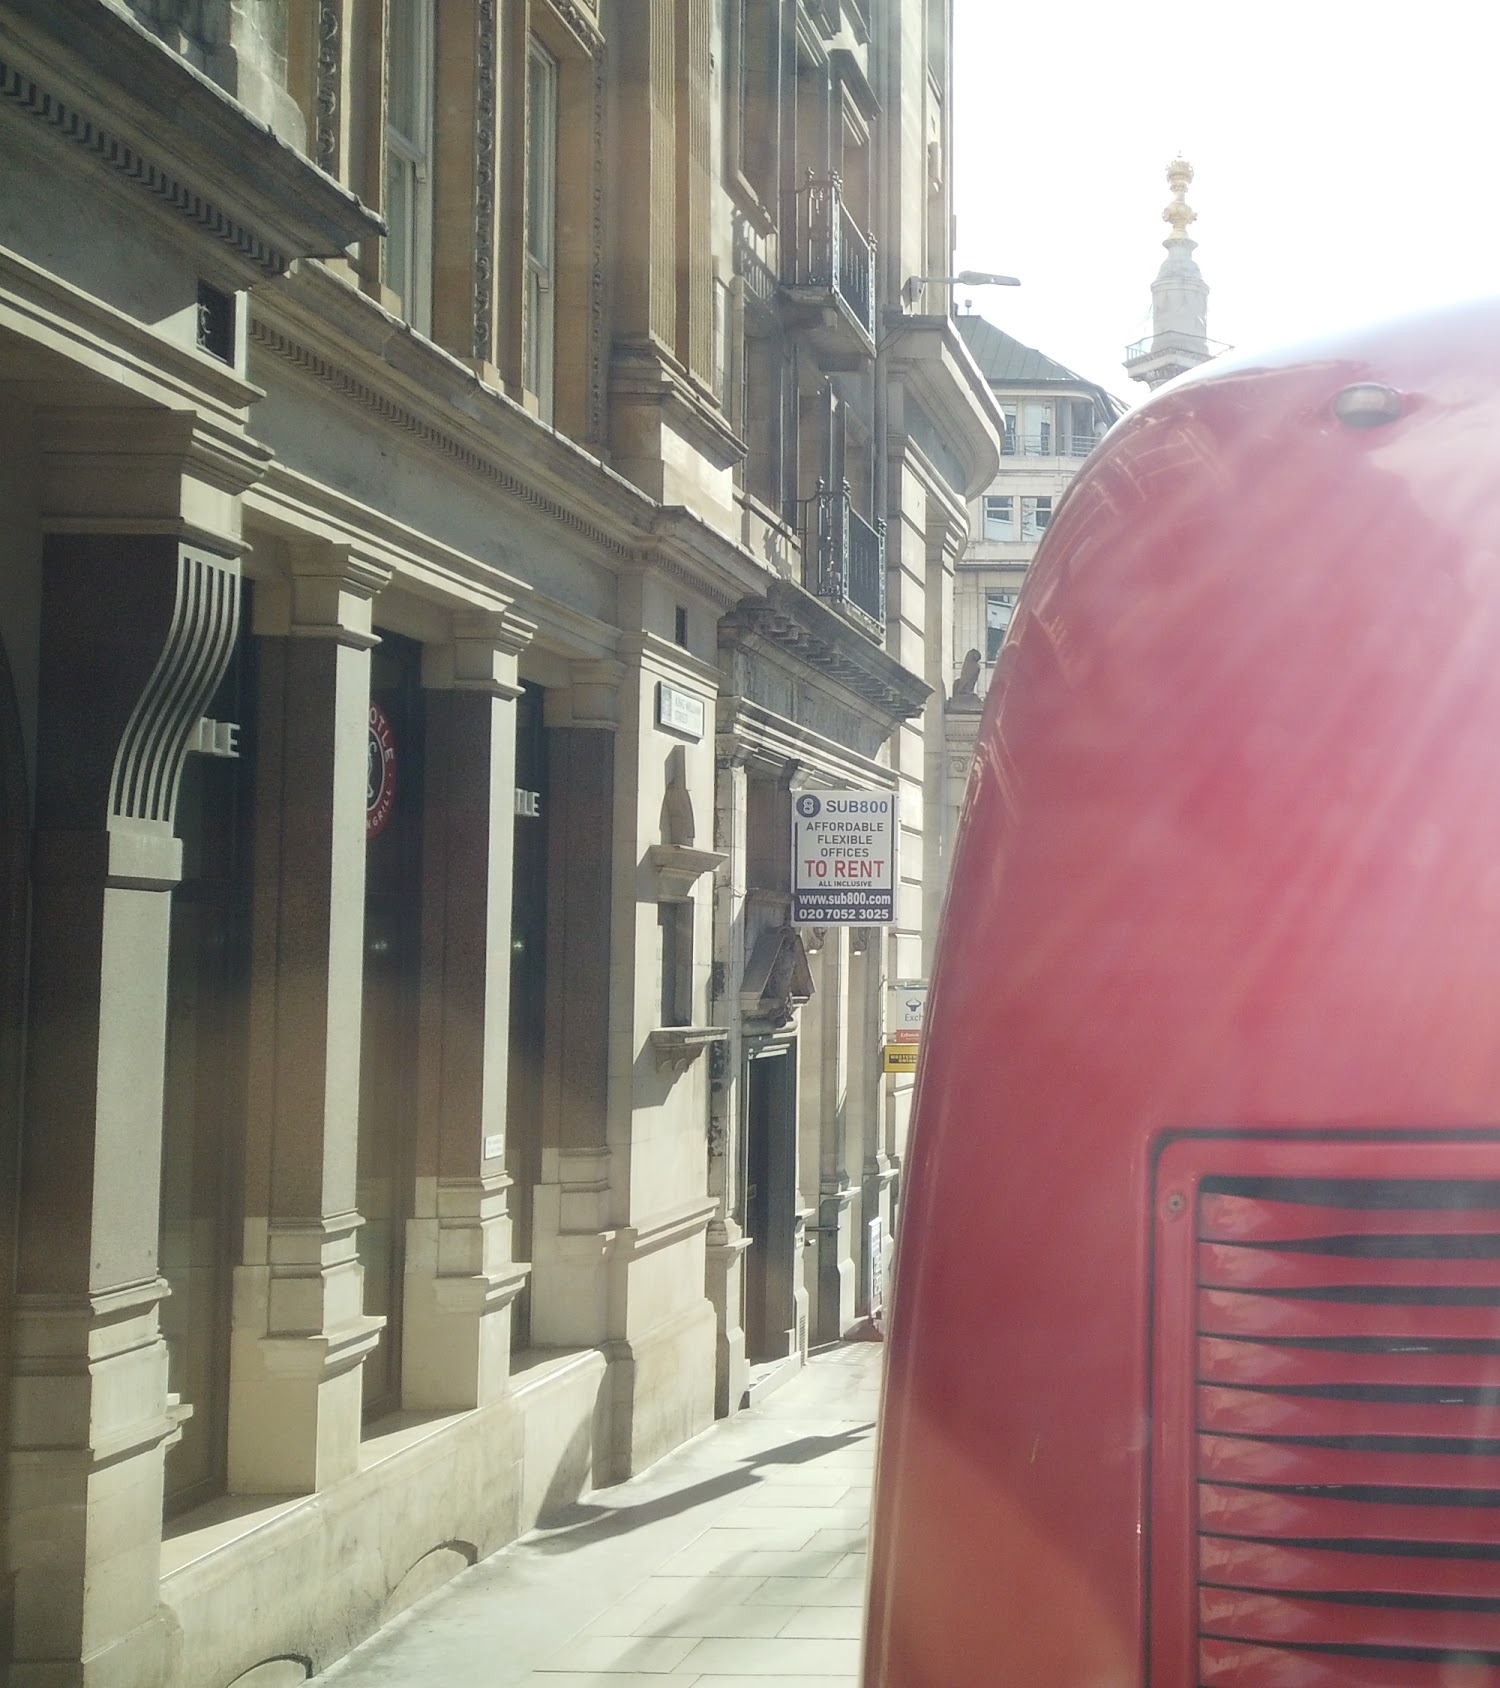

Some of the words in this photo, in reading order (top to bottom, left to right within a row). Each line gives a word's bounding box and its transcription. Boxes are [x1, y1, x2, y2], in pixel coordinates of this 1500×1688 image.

[826, 800, 888, 814] SUB800
[806, 822, 884, 832] AFFORDABLE
[817, 835, 873, 845] FLEXIBLE
[820, 847, 869, 858] OFFICES
[804, 860, 827, 878] TO
[834, 860, 884, 878] RENT
[834, 880, 873, 888] INCLUSIVE
[798, 892, 891, 905] www.sub800.com
[799, 909, 823, 920] 020
[825, 909, 856, 920] 7052
[859, 909, 889, 920] 3025
